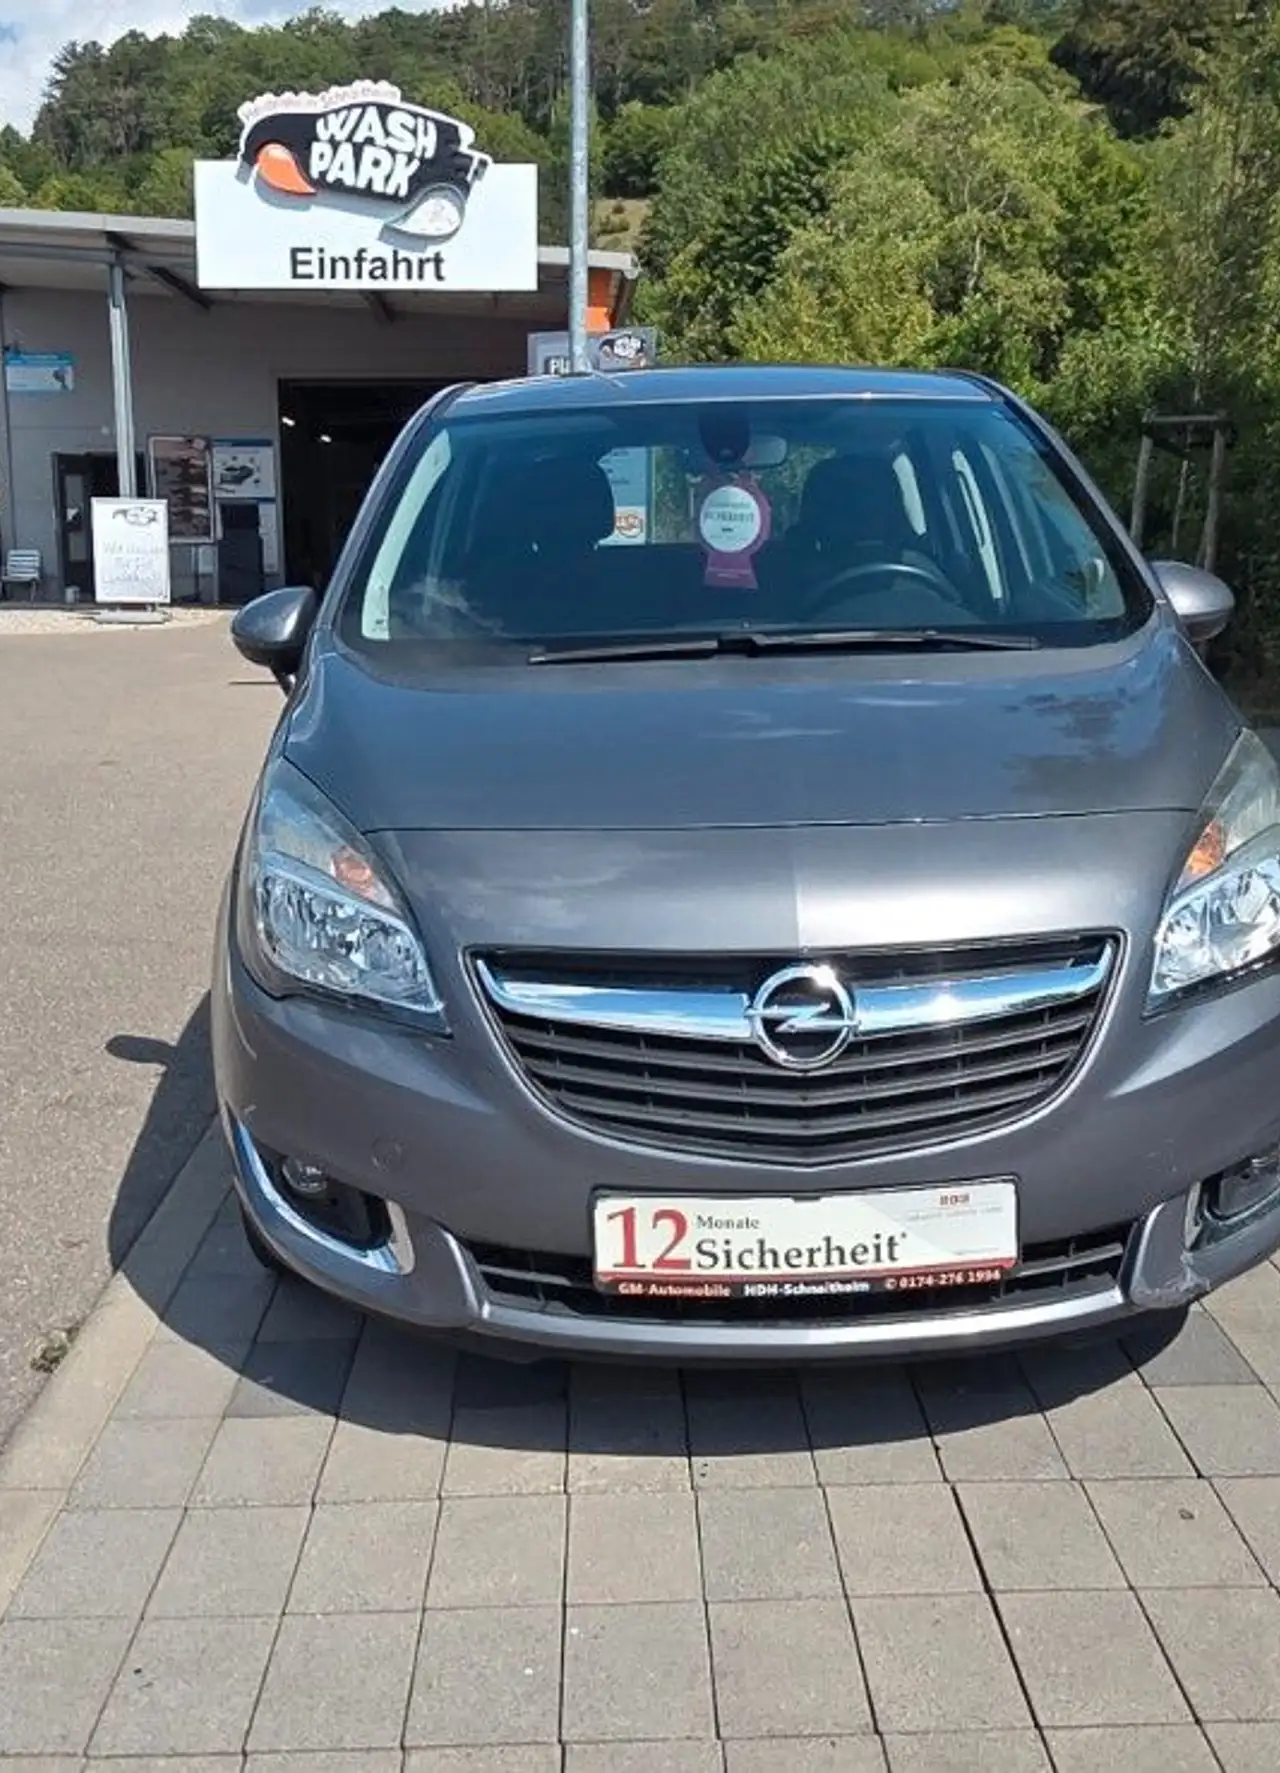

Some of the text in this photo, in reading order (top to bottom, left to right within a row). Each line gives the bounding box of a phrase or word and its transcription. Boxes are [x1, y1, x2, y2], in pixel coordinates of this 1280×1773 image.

[315, 105, 437, 159] WASH
[309, 141, 420, 197] PARK
[289, 247, 445, 281] Einfahrt
[607, 1207, 692, 1269] 12
[696, 1214, 760, 1230] Monate
